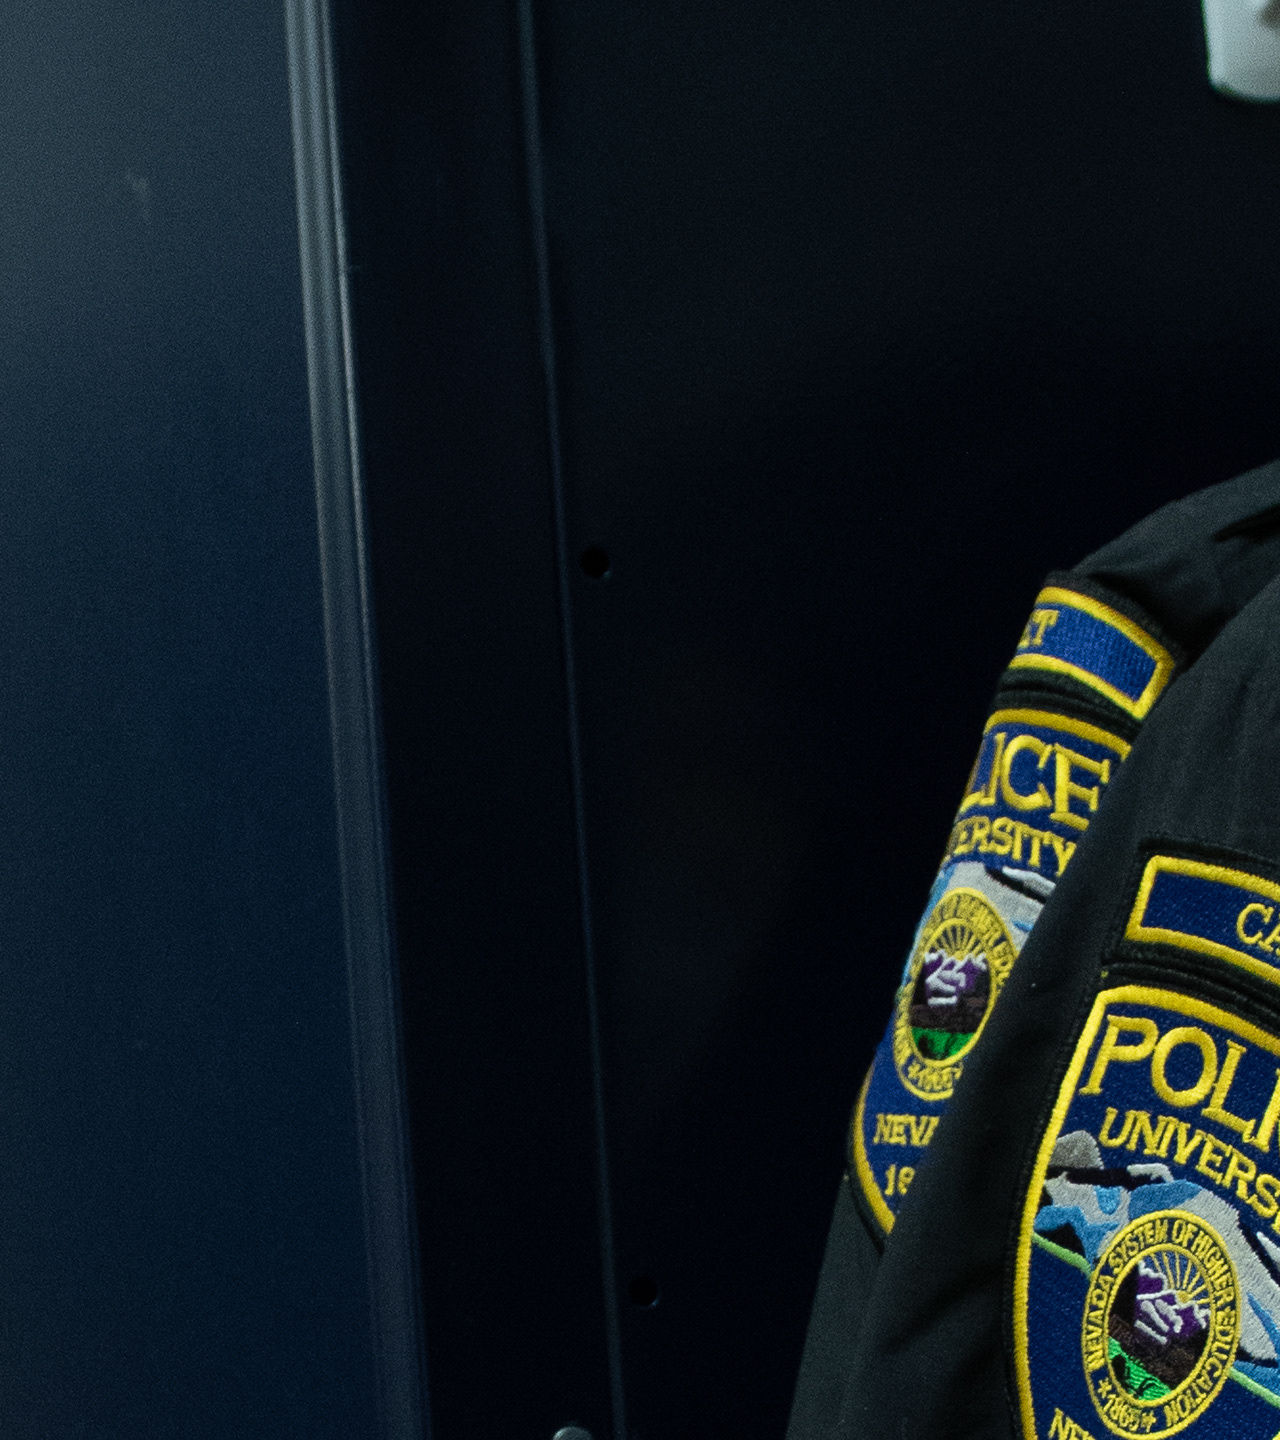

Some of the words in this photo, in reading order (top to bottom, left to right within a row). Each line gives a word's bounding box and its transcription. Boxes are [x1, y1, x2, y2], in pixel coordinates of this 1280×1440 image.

[960, 732, 1111, 832] LICE
[949, 816, 1077, 878] ERSITY
[873, 1113, 940, 1147] NEV
[884, 1164, 916, 1196] 18
[1108, 1219, 1169, 1275] SYSTEM
[1172, 1219, 1198, 1248] OF
[1190, 1230, 1235, 1307] HIGHER
[1086, 1274, 1115, 1371] NEVADA
[1162, 1306, 1237, 1427] EDUCATION
